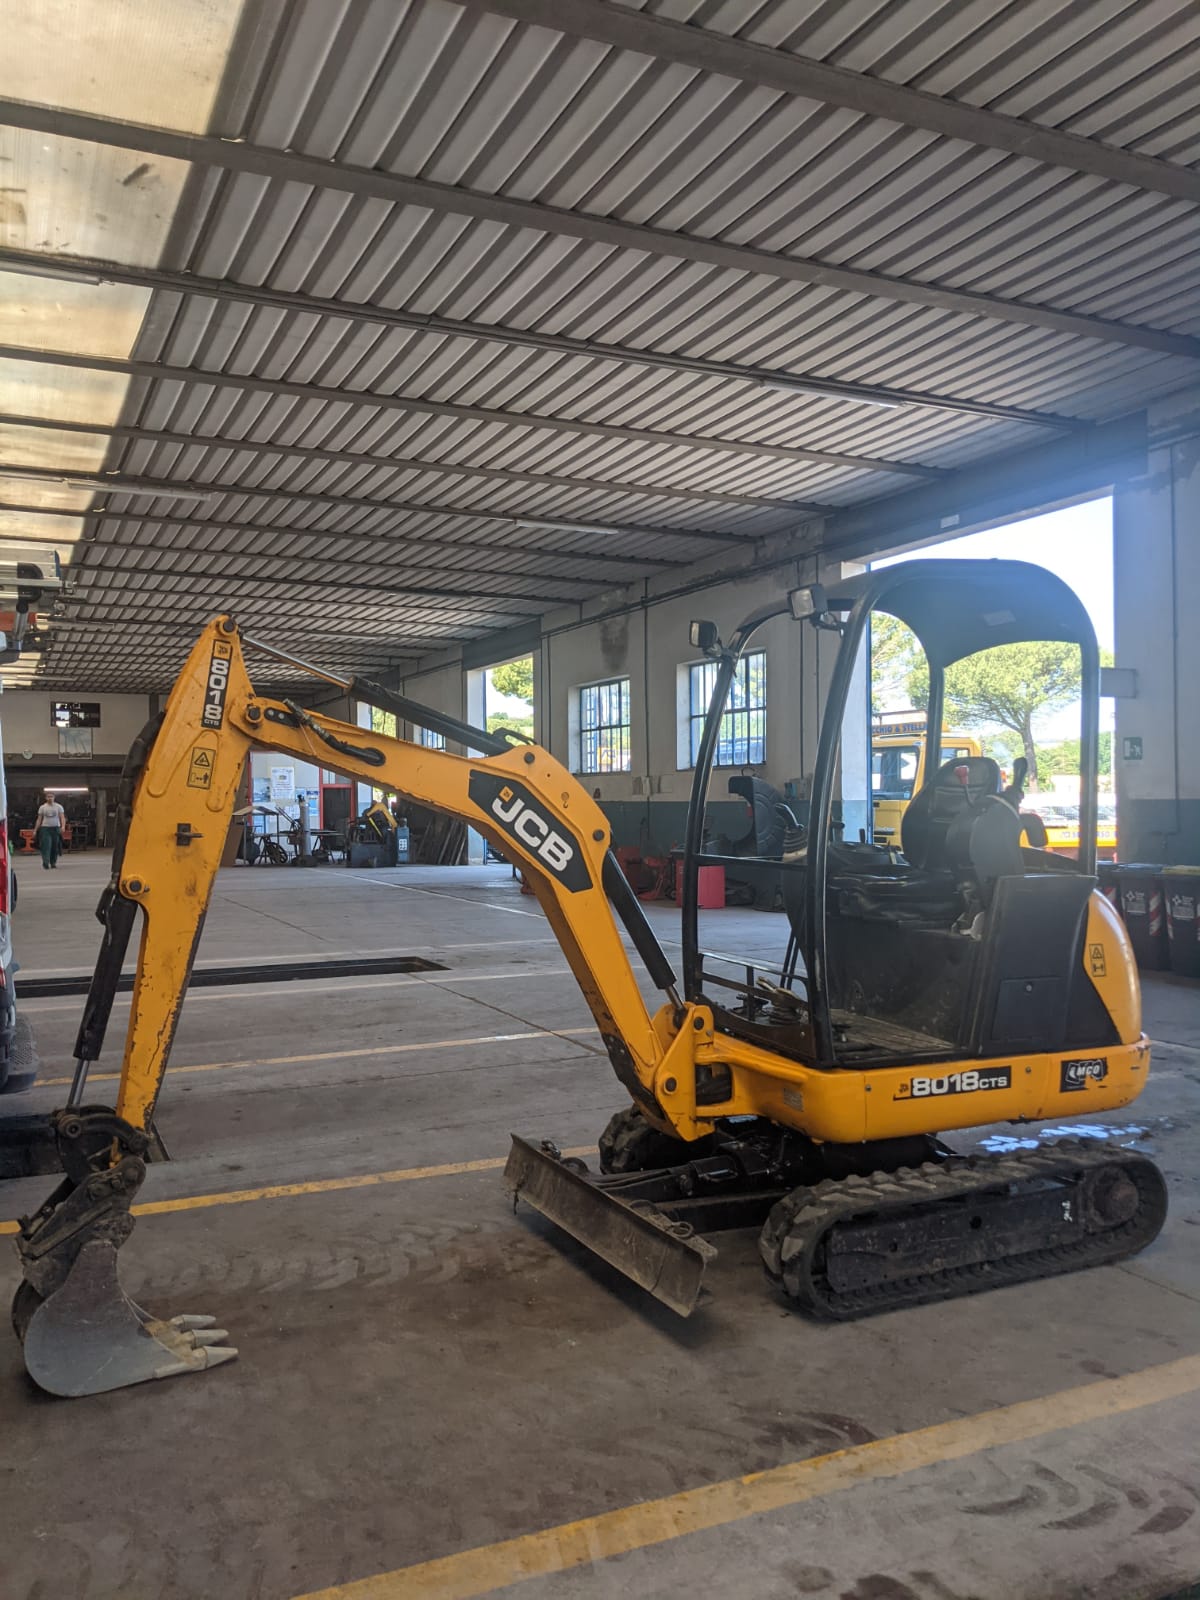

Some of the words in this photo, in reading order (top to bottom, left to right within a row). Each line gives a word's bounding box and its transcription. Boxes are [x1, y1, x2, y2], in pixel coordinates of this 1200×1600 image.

[204, 658, 229, 720] 8018
[204, 718, 220, 726] CTS
[492, 798, 573, 871] JCB
